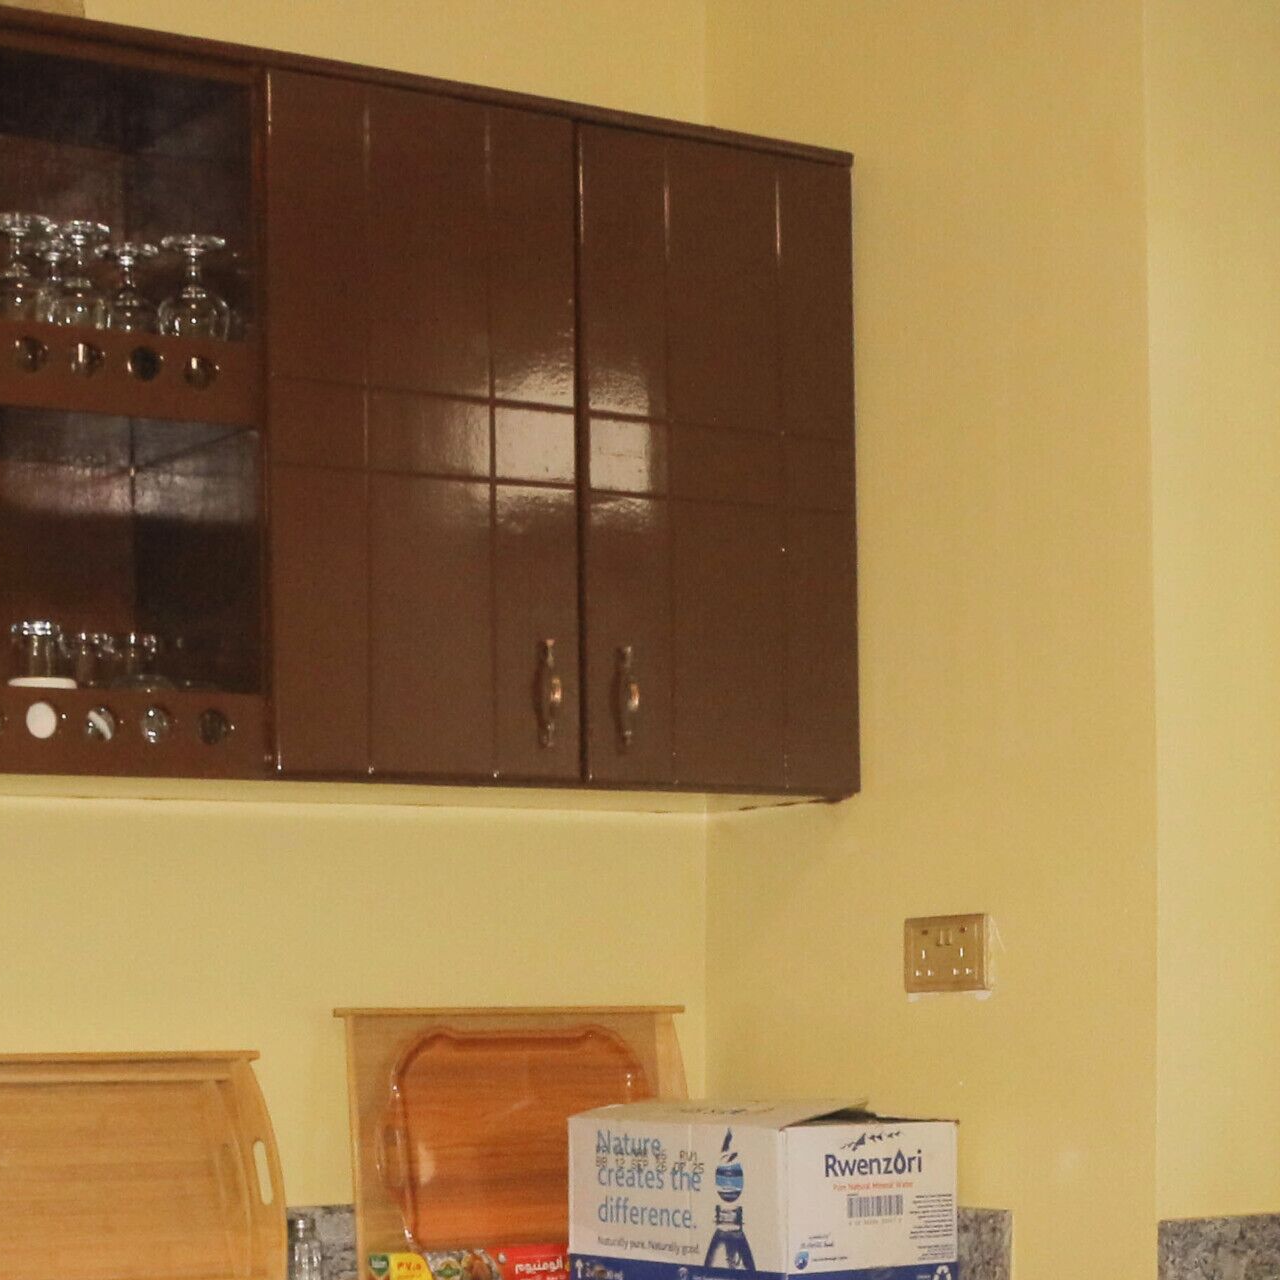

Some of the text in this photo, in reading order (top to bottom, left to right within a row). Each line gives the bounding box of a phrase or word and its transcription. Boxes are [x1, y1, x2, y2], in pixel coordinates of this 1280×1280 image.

[596, 1129, 661, 1156] Nature
[824, 1149, 922, 1177] Rwenzori
[597, 1164, 703, 1192] creates the
[597, 1195, 698, 1229] difference.
